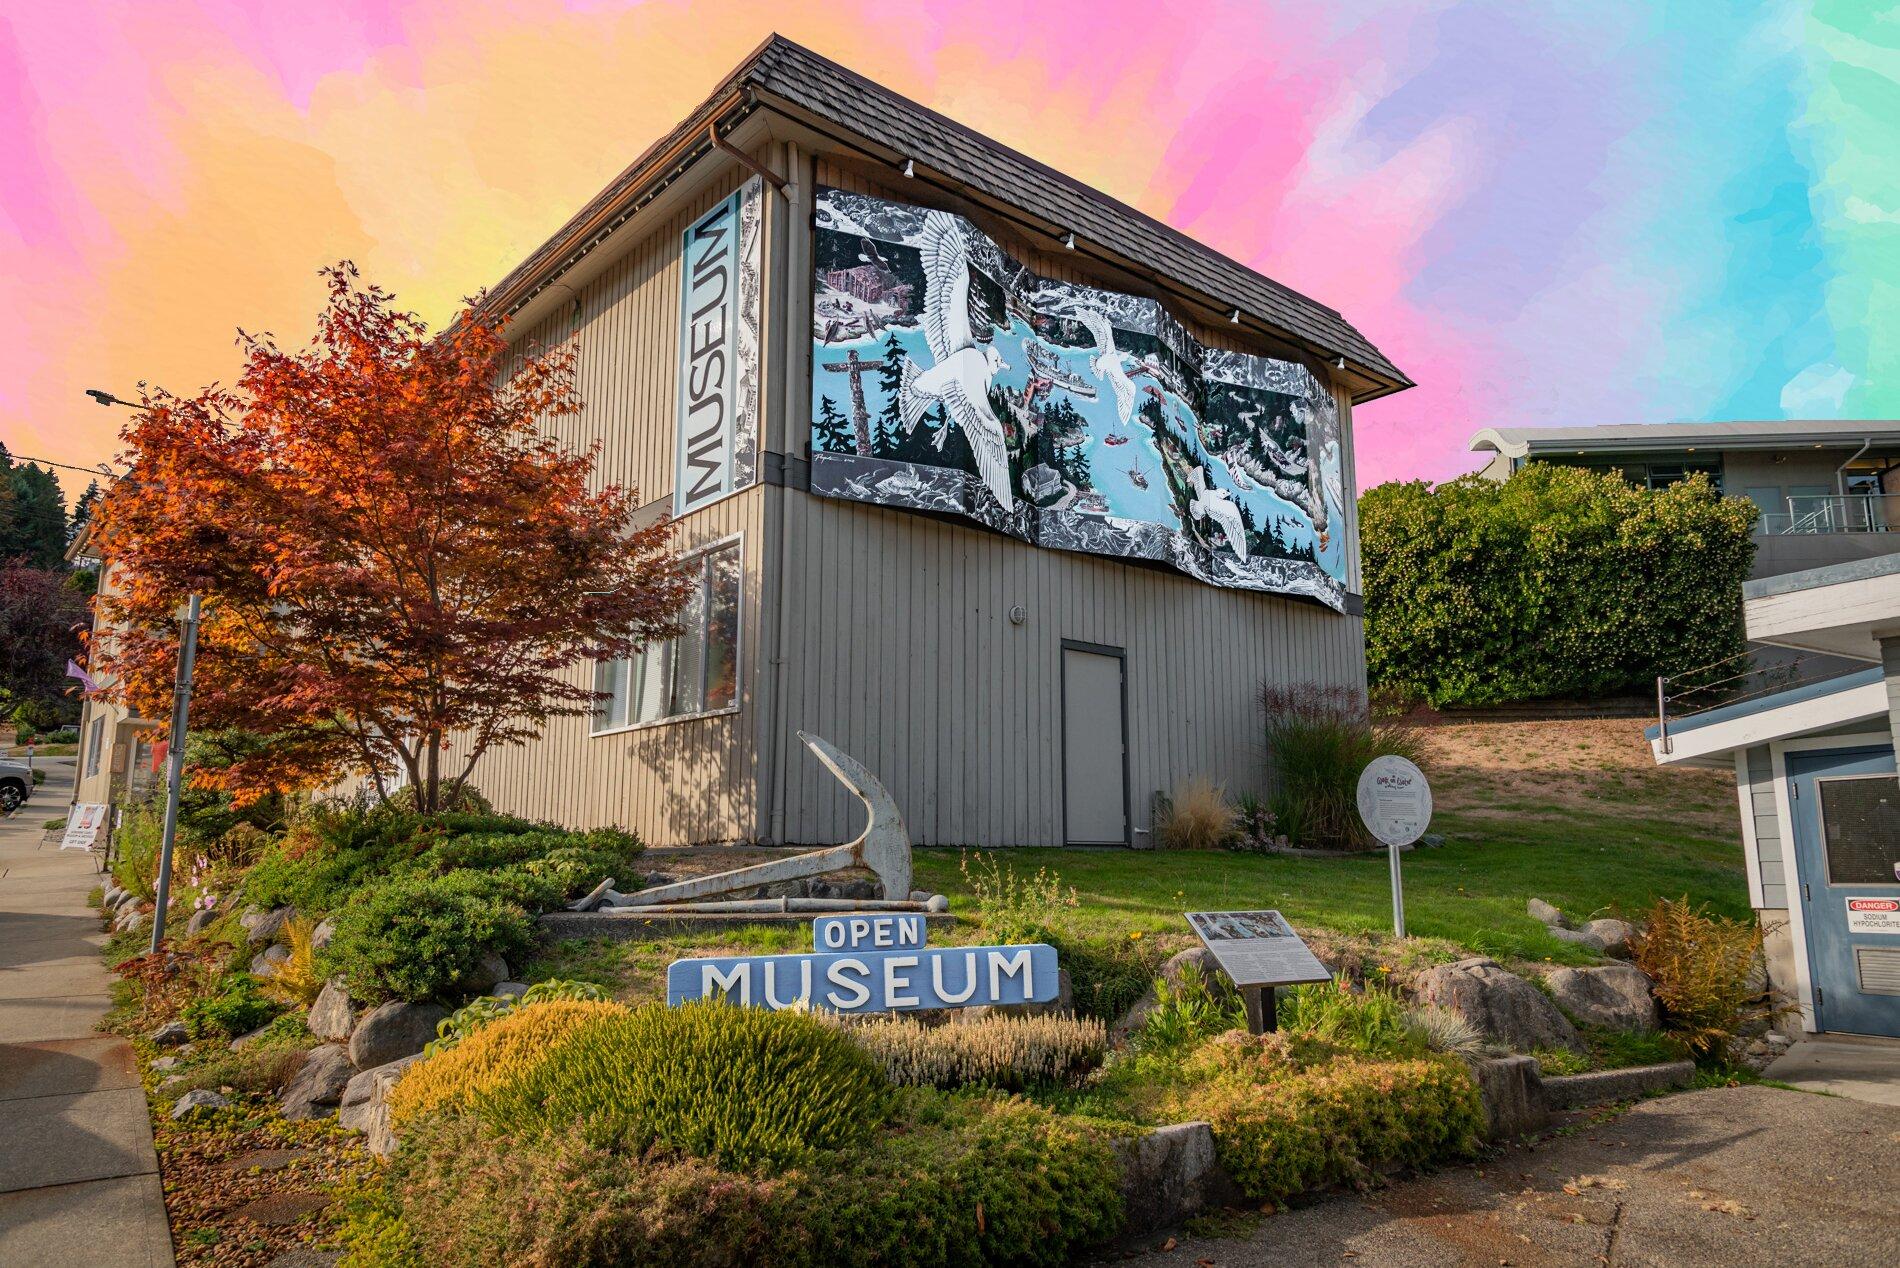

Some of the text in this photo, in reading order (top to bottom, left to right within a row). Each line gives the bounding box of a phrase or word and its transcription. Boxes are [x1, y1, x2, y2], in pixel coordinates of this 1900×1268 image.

[685, 203, 729, 507] MUSEUM
[1855, 902, 1892, 910] DANGER
[824, 917, 918, 948] OPEN
[1853, 920, 1900, 928] HYPOCHLORITE
[701, 949, 1034, 1010] MUSEUM
